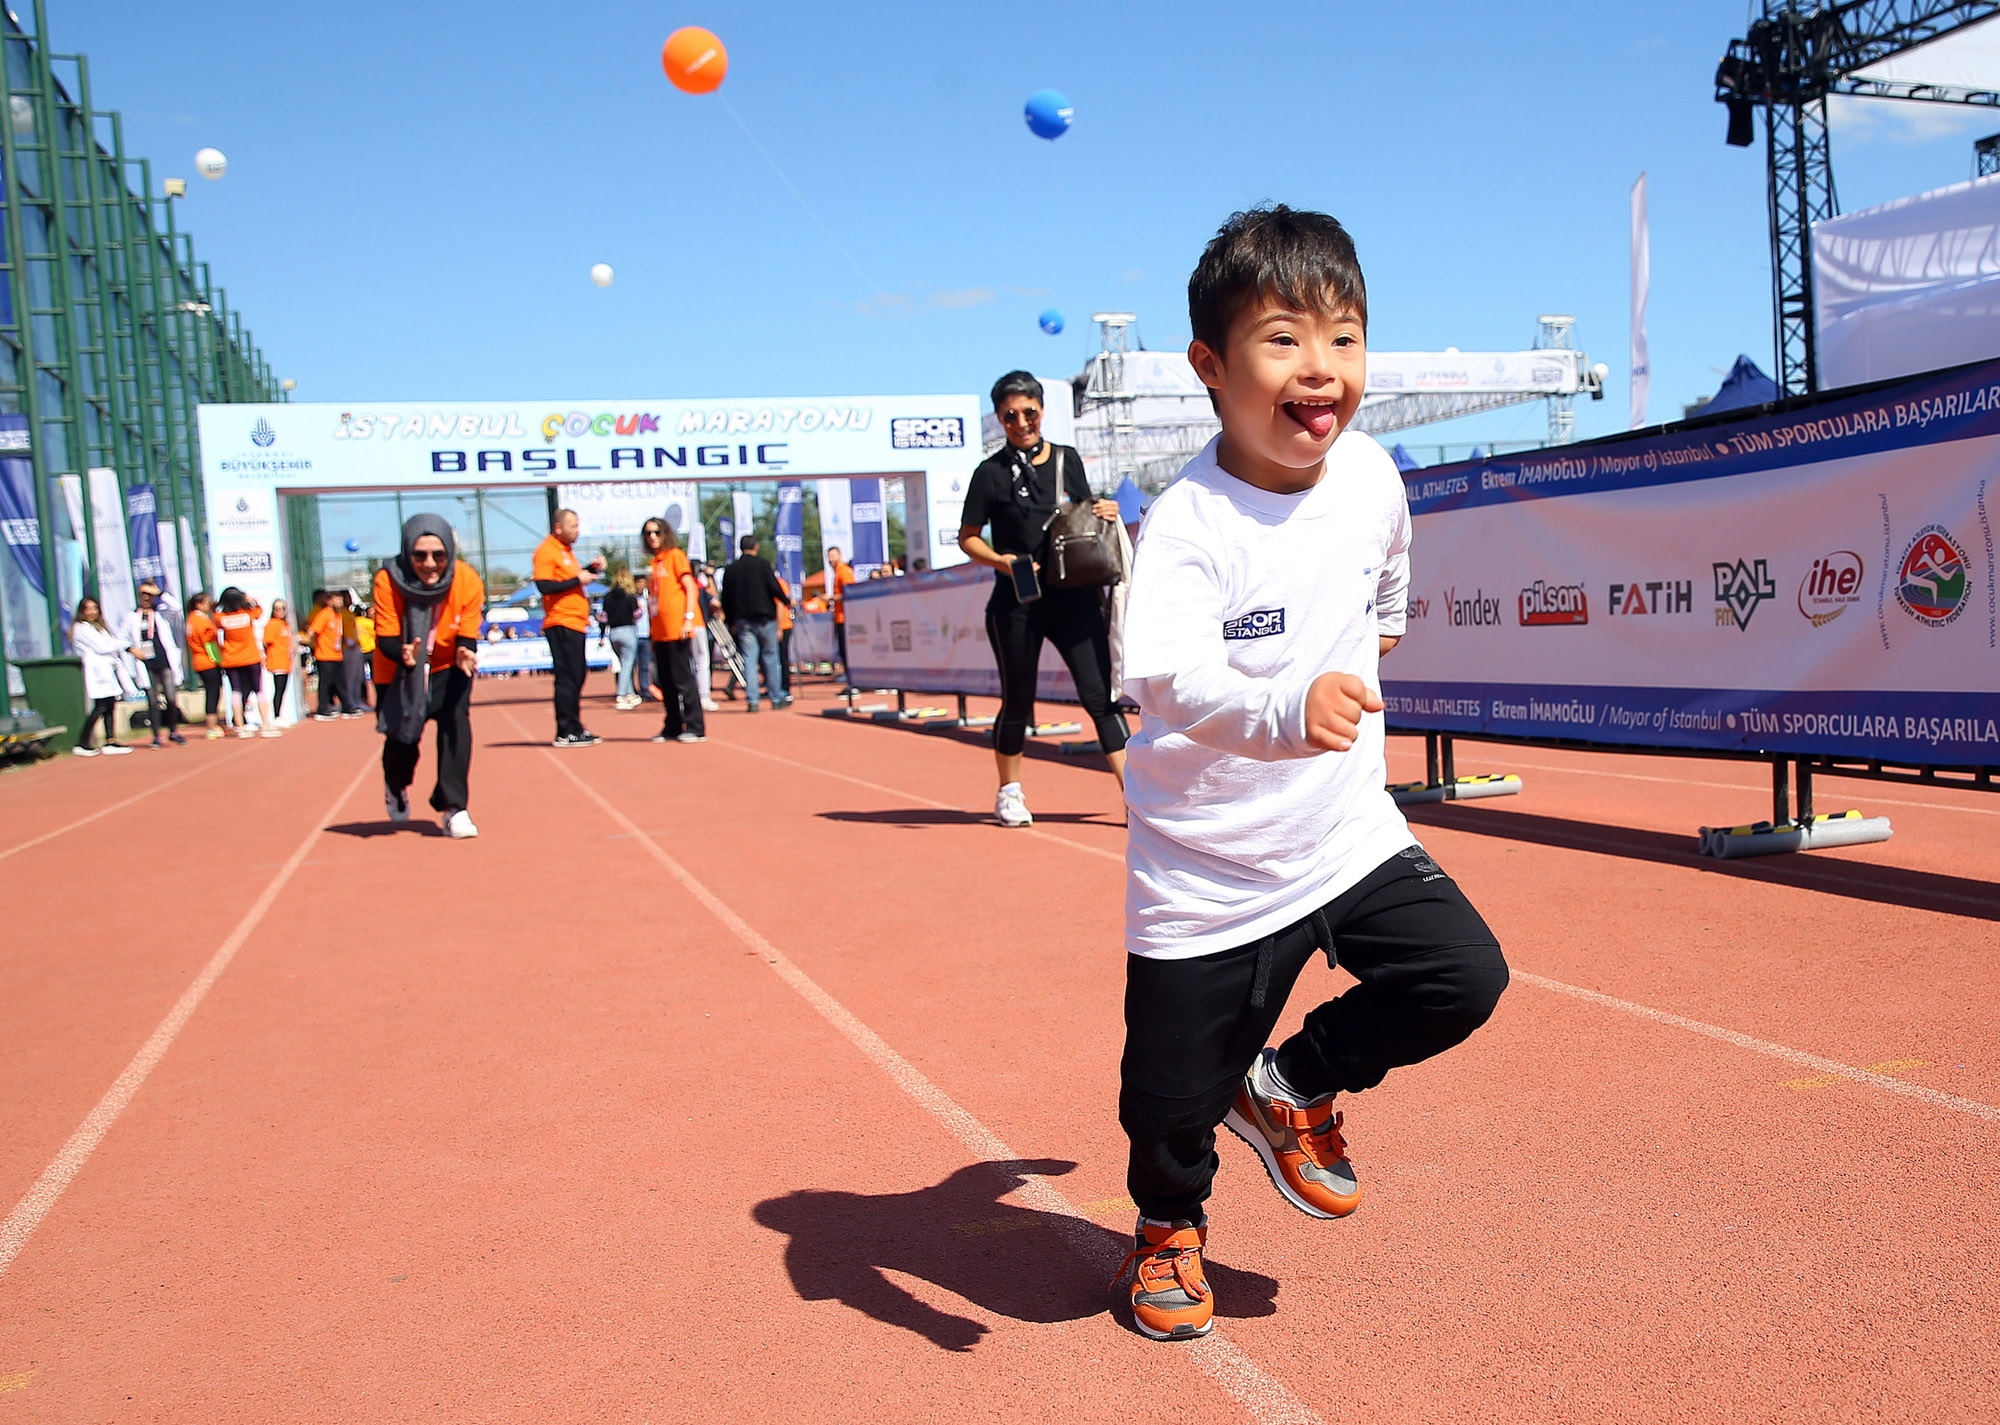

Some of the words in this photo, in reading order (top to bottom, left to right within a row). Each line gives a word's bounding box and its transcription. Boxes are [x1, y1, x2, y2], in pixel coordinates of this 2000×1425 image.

[541, 413, 660, 444] ÇOCUK
[676, 405, 872, 435] MARATONU
[893, 418, 961, 436] SPOR
[431, 443, 790, 478] BAŞLANGIÇ
[1422, 476, 1468, 499] ATHLETES
[1481, 471, 1515, 490] Ekrem
[1518, 457, 1586, 485] İMAMOĞLU
[1601, 454, 1643, 474] Mayor
[1645, 450, 1657, 471] of
[1661, 443, 1714, 467] Istanbul
[1730, 432, 1772, 454] TÜM
[1773, 411, 1891, 447] SPORCULARA
[1808, 558, 1857, 596] ihe
[1225, 612, 1281, 629] SPOR
[1443, 587, 1501, 626] Yandex
[1521, 581, 1584, 621] pilsan
[1401, 697, 1413, 713] TO
[1414, 697, 1431, 714] ALL
[1432, 699, 1480, 717] ATHLETES
[1493, 701, 1527, 720] Ekrem
[1530, 698, 1595, 723] İMAMOĞLU
[1609, 706, 1650, 730] Mayor
[1653, 707, 1667, 732] of
[1670, 709, 1722, 731] Istanbul
[1741, 708, 1780, 733] TÜM
[1783, 714, 1899, 738] SPORCULARA
